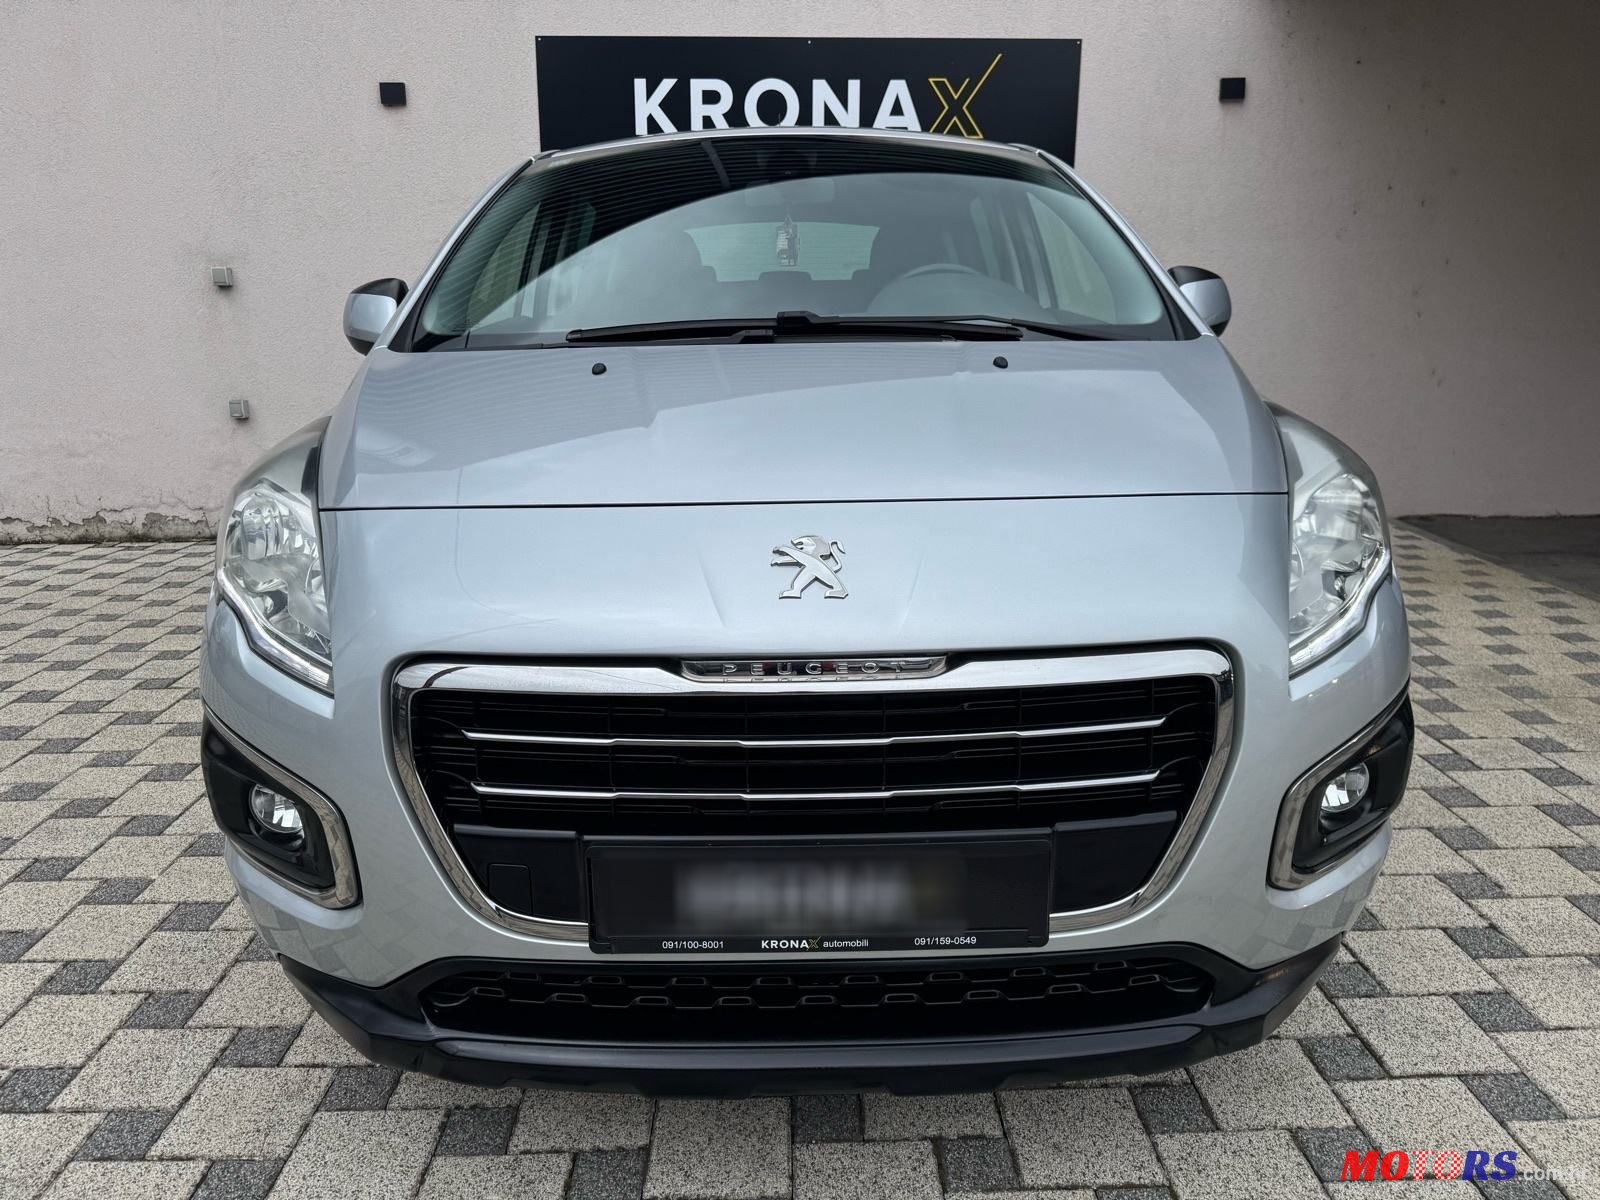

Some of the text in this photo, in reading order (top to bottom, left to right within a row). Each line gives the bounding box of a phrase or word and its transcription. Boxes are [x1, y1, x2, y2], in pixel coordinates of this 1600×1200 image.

[633, 53, 1003, 139] KRONAX
[722, 660, 908, 676] PEUGEOT
[661, 935, 978, 950] 091/100-8001 KRONAX automobili 091/159-0549
